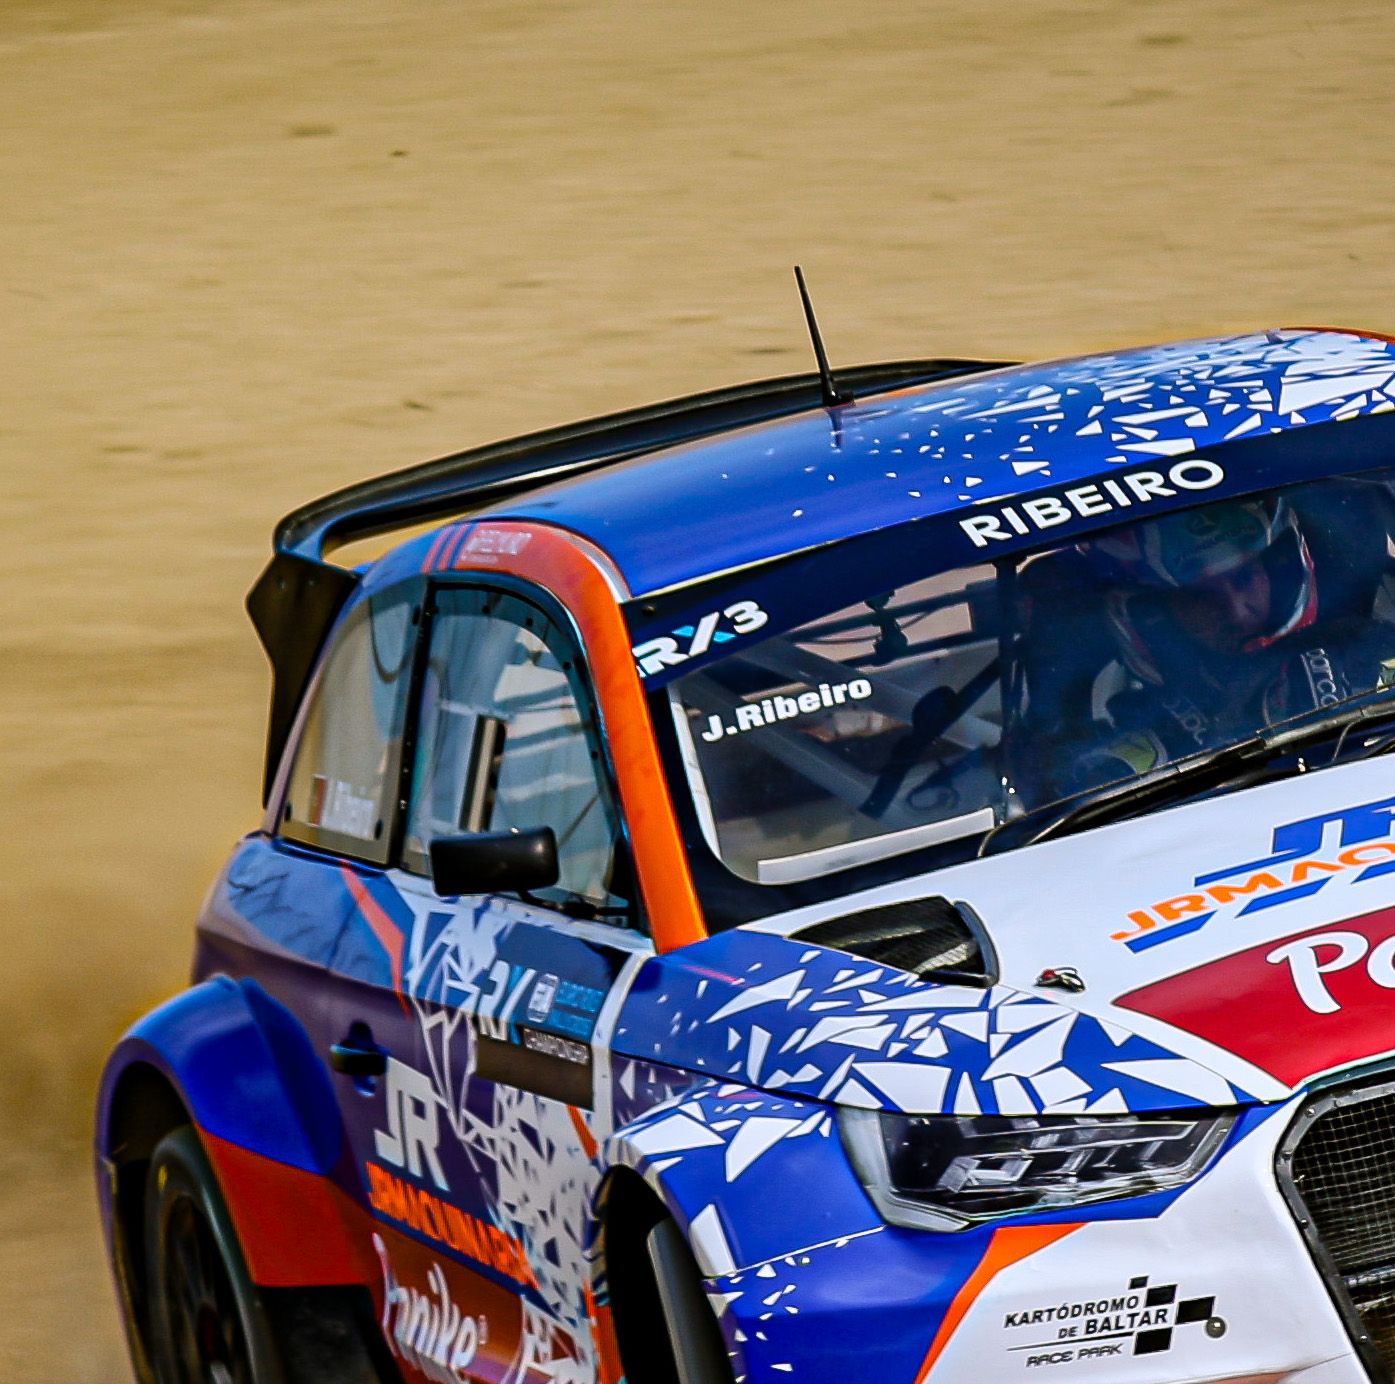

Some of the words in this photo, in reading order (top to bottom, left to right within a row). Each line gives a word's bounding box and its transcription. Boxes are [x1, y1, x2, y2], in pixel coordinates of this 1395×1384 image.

[959, 459, 1224, 548] RIBEIRO
[701, 679, 872, 743] J.Ribeiro
[1003, 1295, 1140, 1329] KARTÓDROMO
[1057, 1325, 1079, 1339] DE
[1084, 1308, 1169, 1336] BALTAR
[1026, 1348, 1074, 1368] RACE
[1076, 1343, 1124, 1361] PARK
